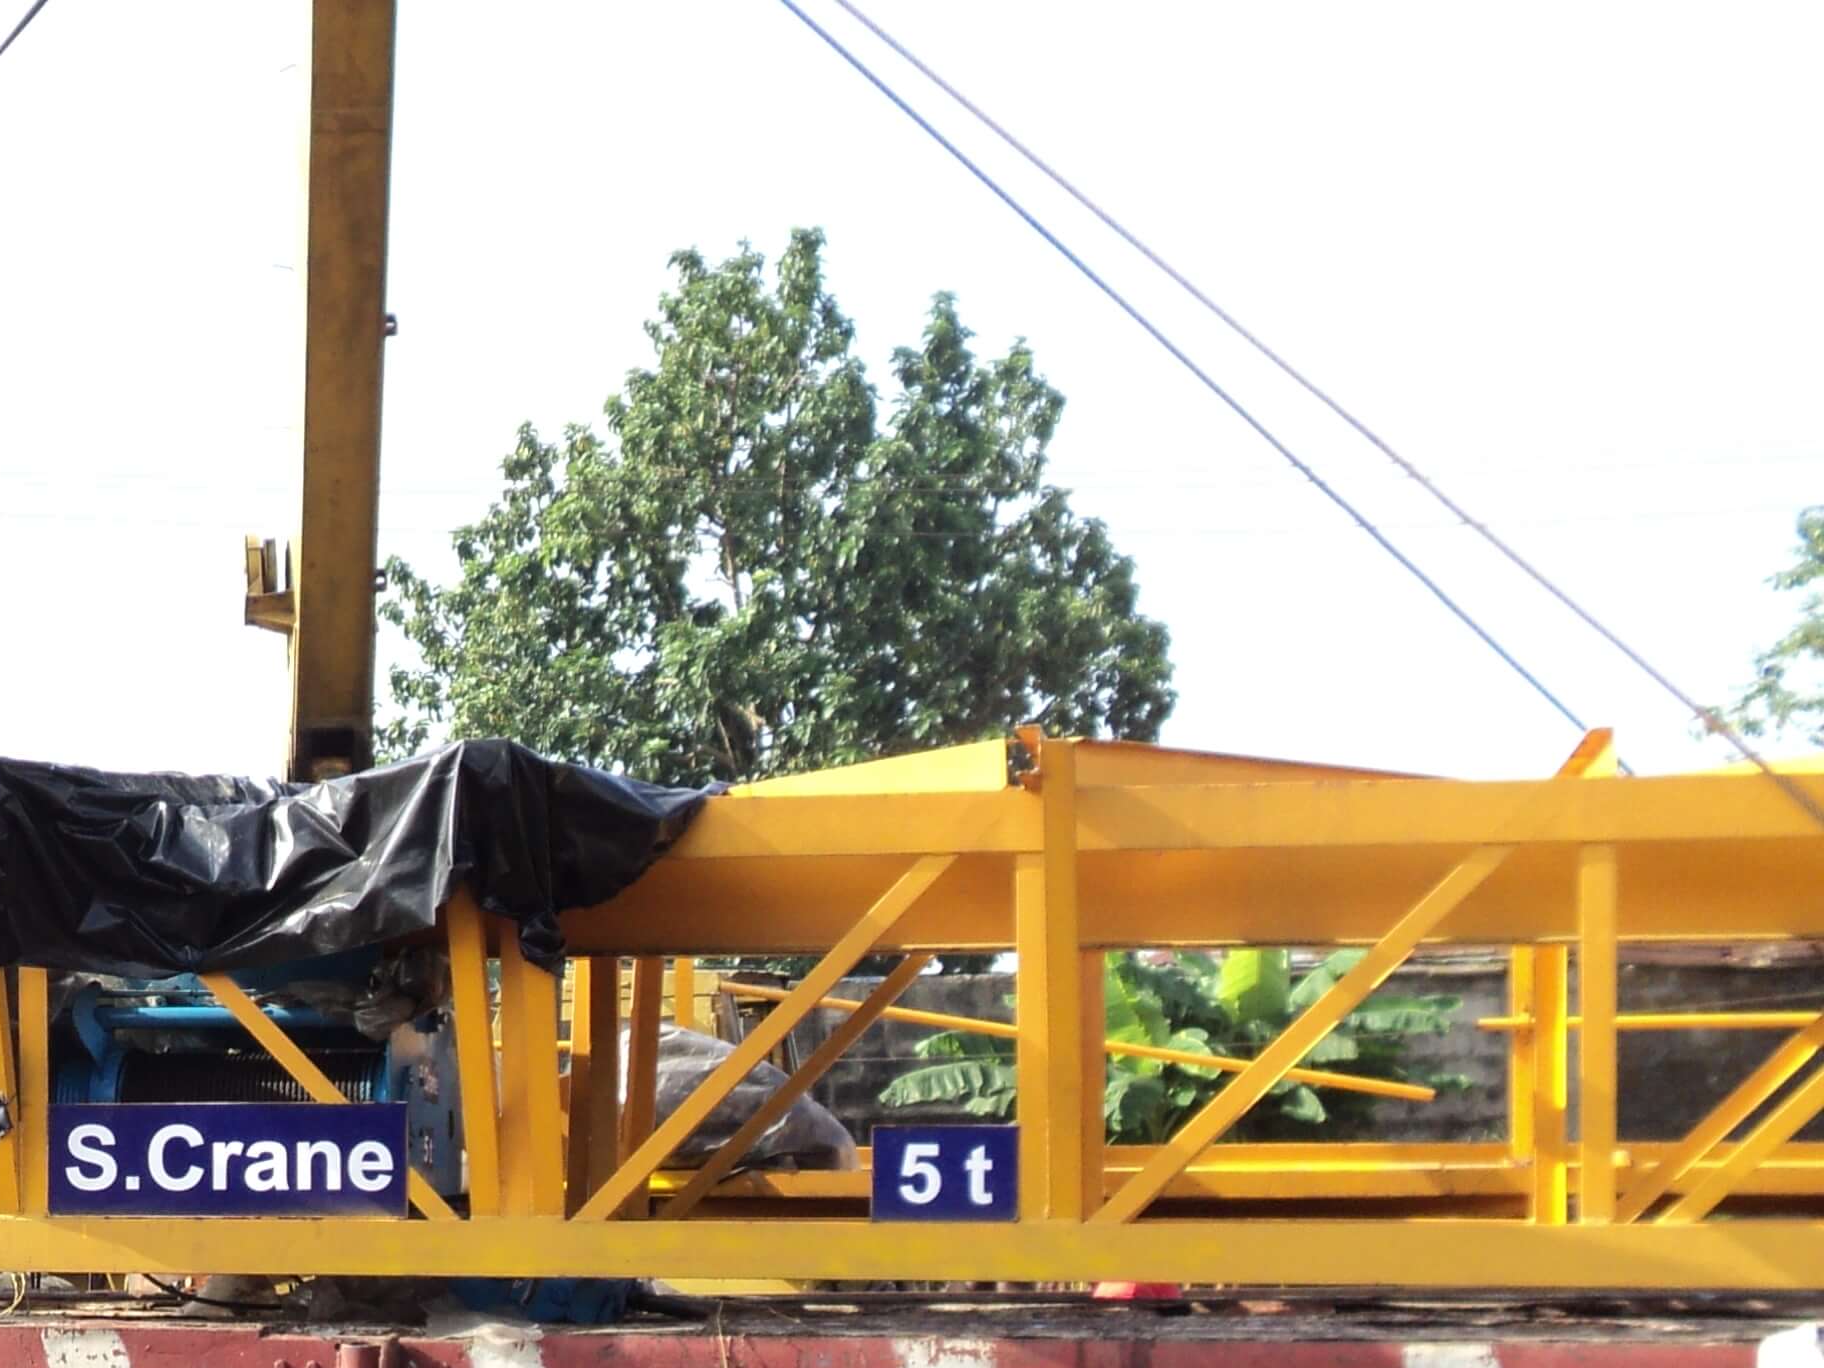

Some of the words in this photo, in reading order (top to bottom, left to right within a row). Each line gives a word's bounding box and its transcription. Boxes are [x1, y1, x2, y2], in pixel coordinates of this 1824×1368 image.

[65, 1123, 394, 1193] S.Crane
[899, 1143, 942, 1205] 5
[965, 1144, 994, 1206] t
